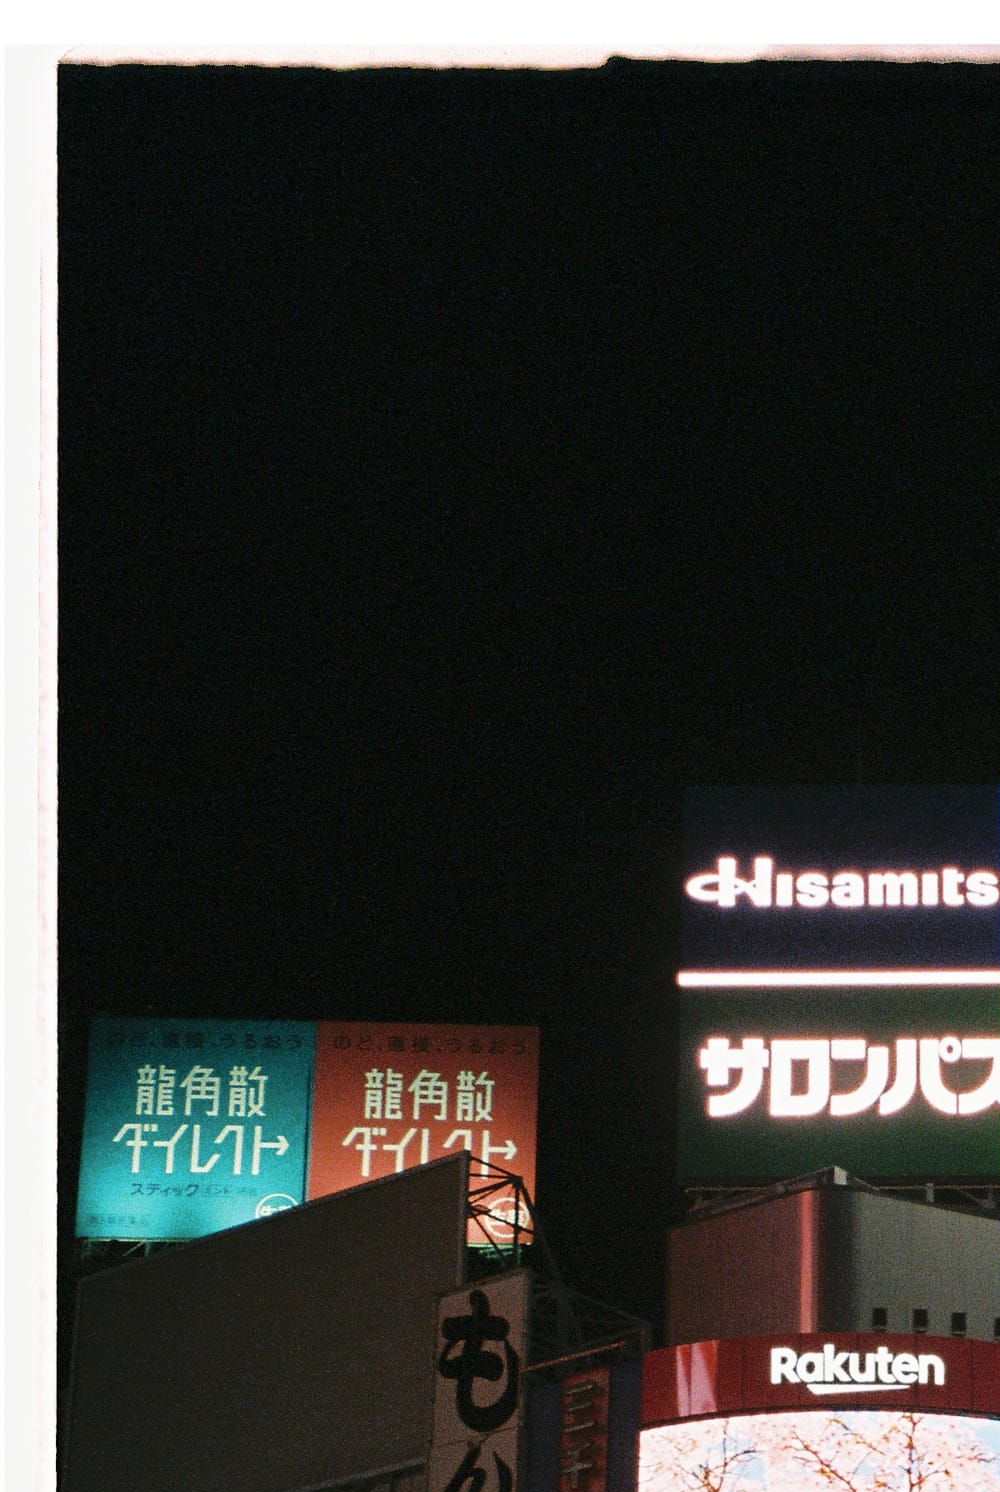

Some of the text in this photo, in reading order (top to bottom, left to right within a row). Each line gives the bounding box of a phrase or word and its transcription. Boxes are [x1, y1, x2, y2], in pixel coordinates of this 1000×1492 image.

[135, 1063, 269, 1118] 龍角散
[363, 1067, 495, 1123] 龍角散
[112, 1122, 289, 1176] ダイレクト
[769, 1343, 946, 1387] Rakuten
